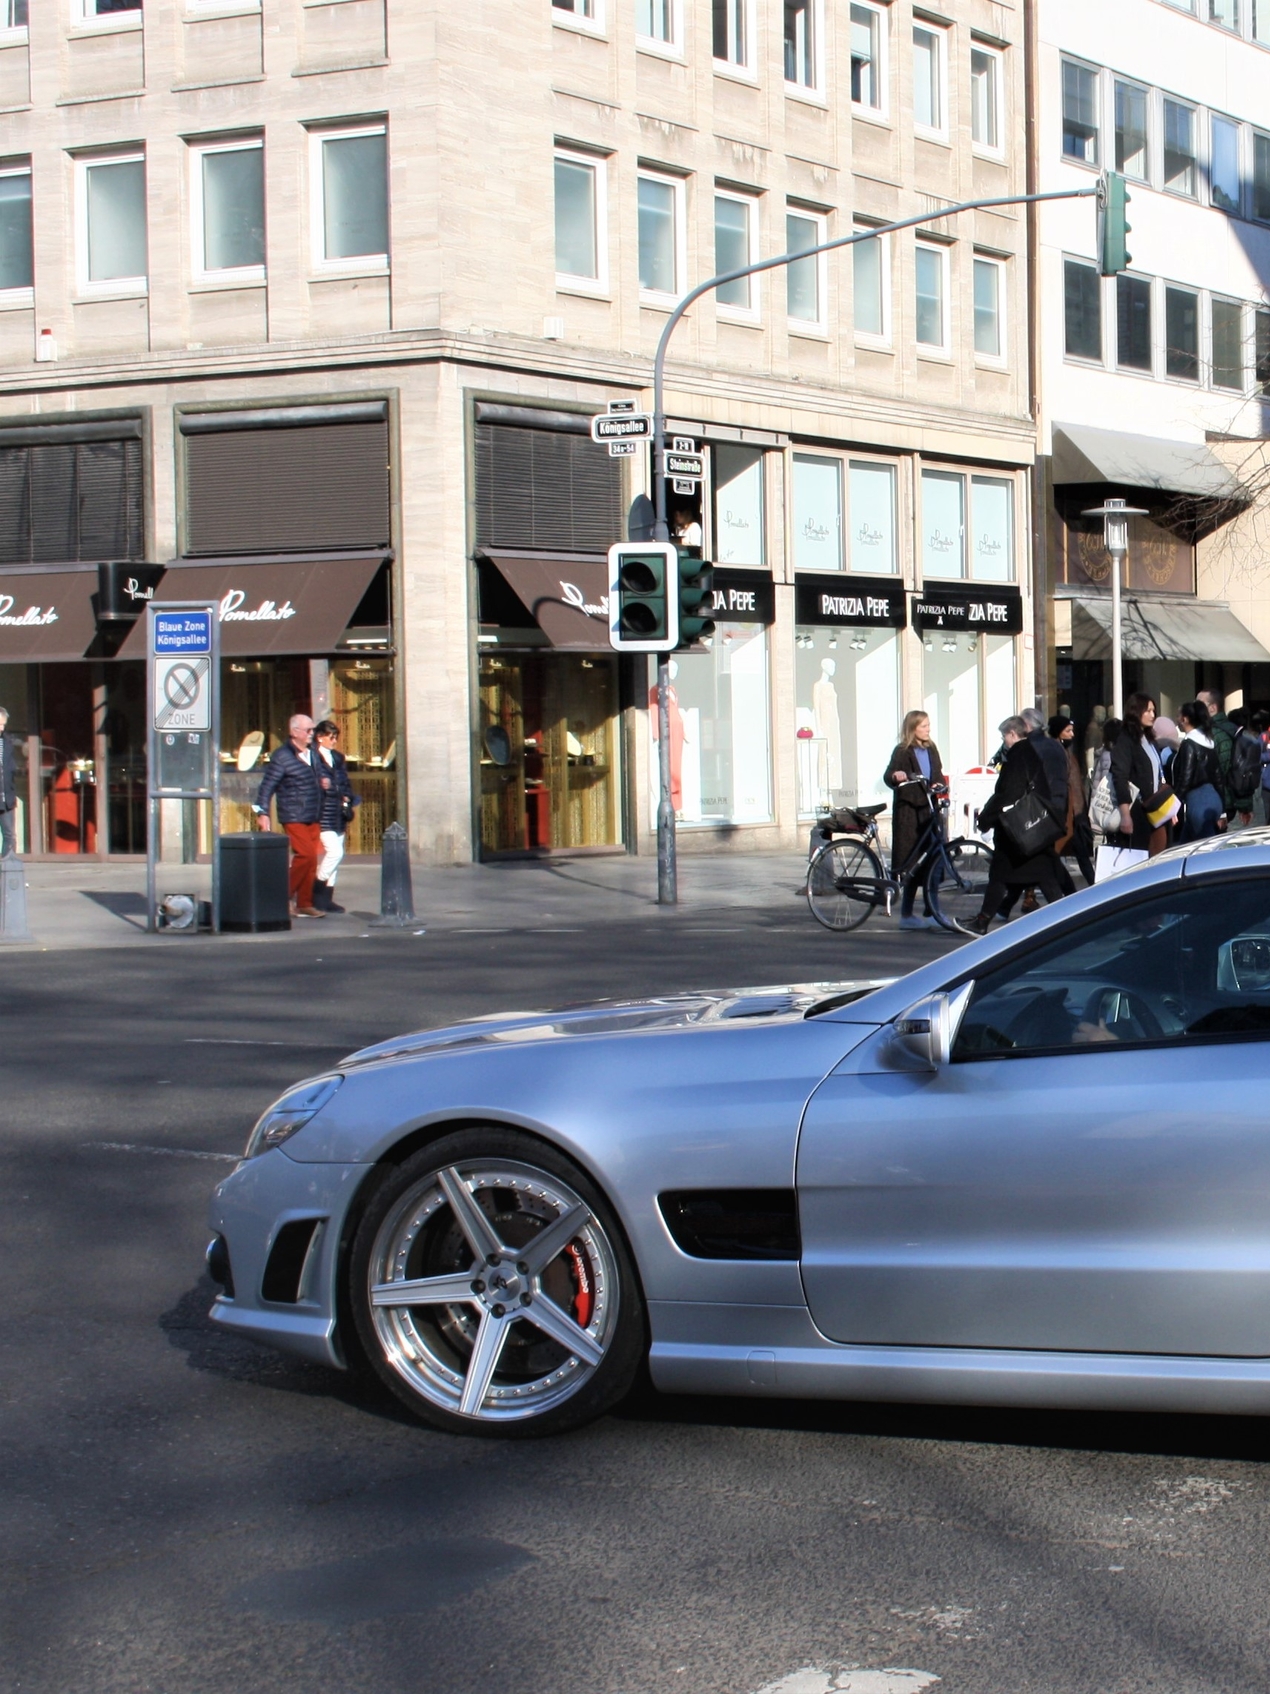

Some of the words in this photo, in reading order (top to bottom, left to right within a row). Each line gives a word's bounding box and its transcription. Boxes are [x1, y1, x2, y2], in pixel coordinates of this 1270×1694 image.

[599, 420, 644, 435] Königsallee
[669, 457, 701, 473] Steinstraße
[124, 577, 153, 600] Pomell
[219, 589, 296, 622] Pomellato
[730, 589, 755, 611] PEPE
[822, 594, 864, 616] PATRIZIA
[867, 596, 890, 617] PEPE
[916, 604, 946, 615] PATRIZIA
[948, 606, 965, 616] PEPE
[987, 603, 1008, 621] PEPE
[159, 621, 182, 632] Blaue
[185, 621, 206, 632] Zone
[157, 634, 207, 648] Königsallee
[168, 713, 196, 725] ZONE
